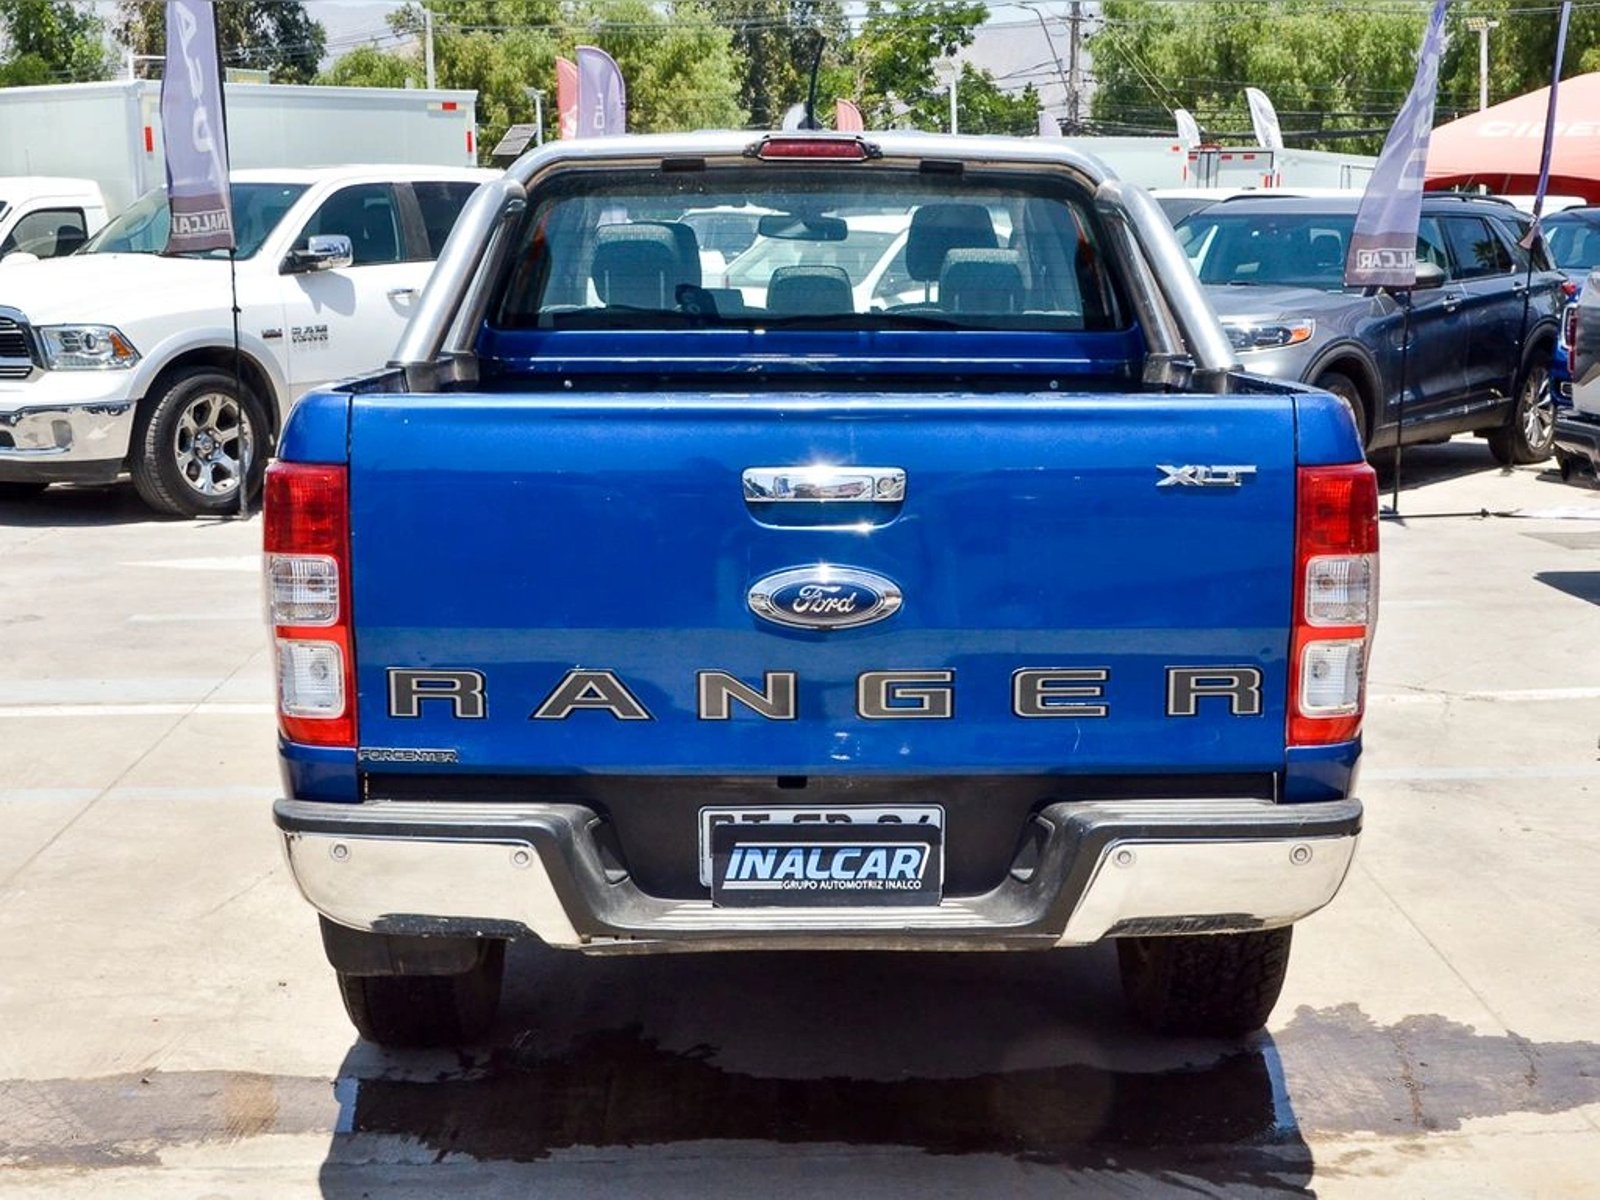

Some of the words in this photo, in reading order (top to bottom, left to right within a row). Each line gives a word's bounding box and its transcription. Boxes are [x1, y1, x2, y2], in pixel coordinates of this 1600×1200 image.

[1156, 464, 1257, 486] XLT
[793, 585, 857, 613] Ford
[386, 666, 1264, 721] RANGER
[359, 747, 459, 763] FORCENTER
[725, 848, 921, 880] INALCAR
[782, 879, 818, 890] GRUPO
[819, 879, 884, 890] AUTOMOTRIZ
[885, 879, 922, 890] INALCO
